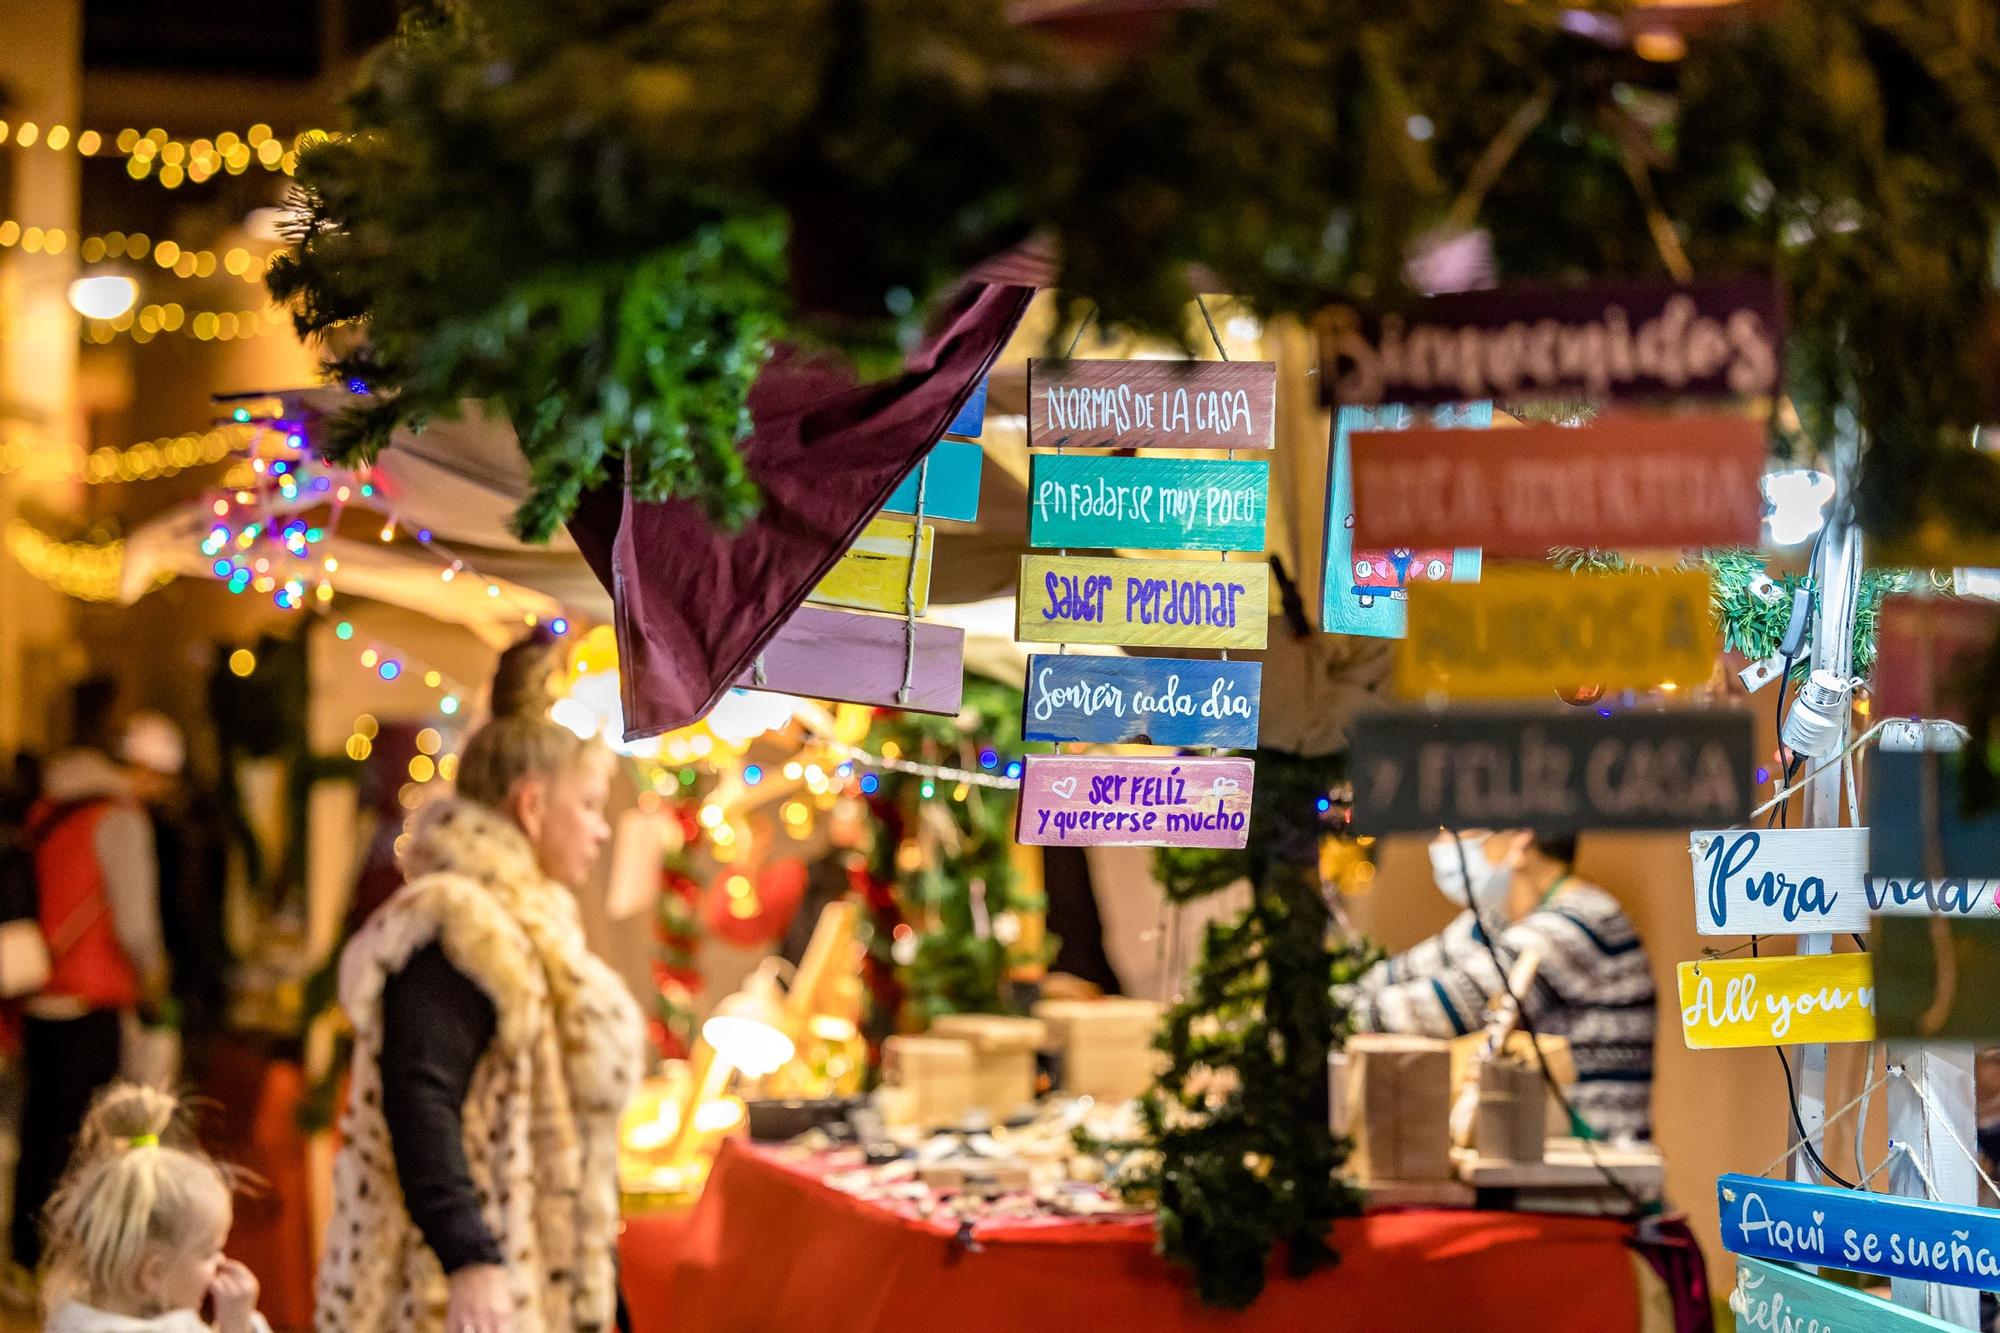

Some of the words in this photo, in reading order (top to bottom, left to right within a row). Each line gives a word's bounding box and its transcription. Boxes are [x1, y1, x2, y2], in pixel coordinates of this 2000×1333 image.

[1047, 383, 1131, 436] NORMAS
[1135, 393, 1155, 430] DE
[1162, 387, 1190, 434] LA
[1195, 388, 1253, 436] CASA
[1159, 487, 1202, 530] muy
[1042, 571, 1113, 623] Saber
[1132, 674, 1197, 718] cada
[1200, 677, 1251, 720] día
[1129, 766, 1188, 808] FELÍZ
[1037, 808, 1051, 835] y
[1053, 810, 1157, 840] quererse
[1166, 799, 1245, 832] mucho
[1704, 831, 1838, 927] Pura
[1682, 973, 1758, 1027] All
[1765, 986, 1853, 1038] you
[1843, 1228, 1882, 1263] se
